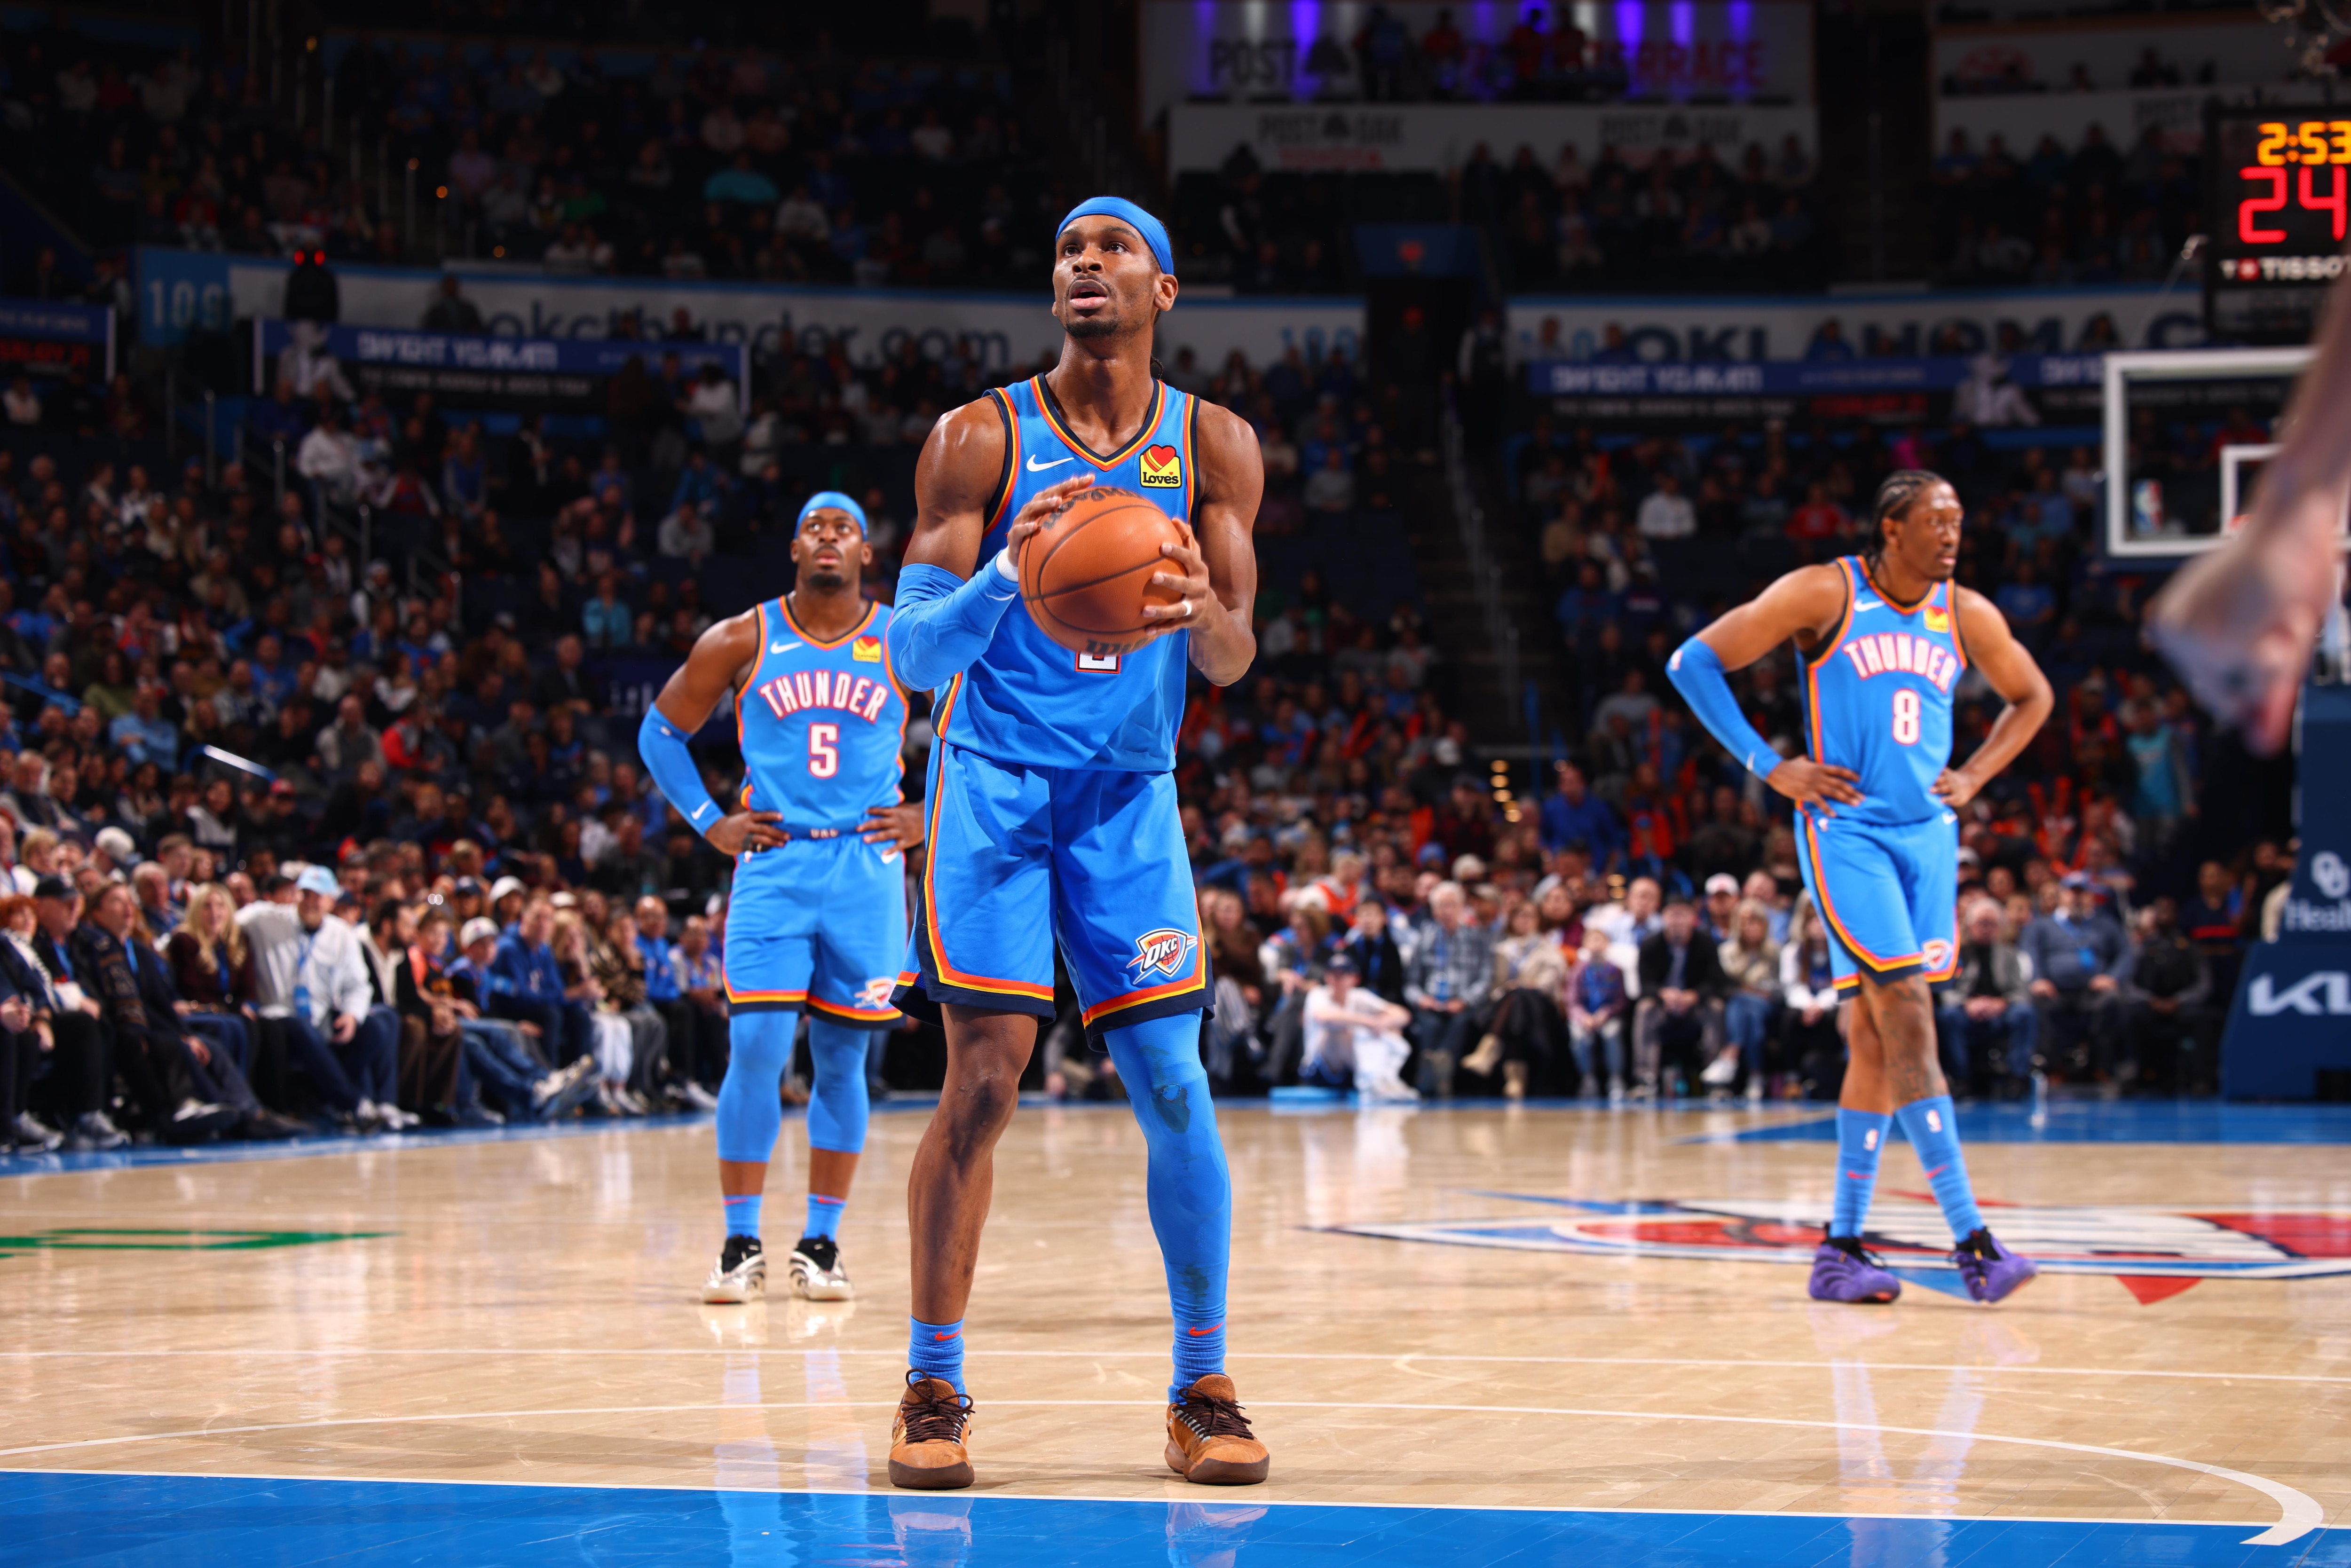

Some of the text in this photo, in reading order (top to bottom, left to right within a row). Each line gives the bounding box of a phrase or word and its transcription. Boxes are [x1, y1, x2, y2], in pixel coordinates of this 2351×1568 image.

[1211, 39, 1298, 85] POST
[2257, 120, 2351, 166] 2:53
[2238, 165, 2348, 244] 24
[1842, 632, 1957, 694] THUNDER
[757, 670, 888, 724] THUNDER
[1893, 688, 1921, 746] 8
[808, 723, 839, 779] 5
[1143, 937, 1178, 969] OKC
[2249, 970, 2351, 1015] KI
